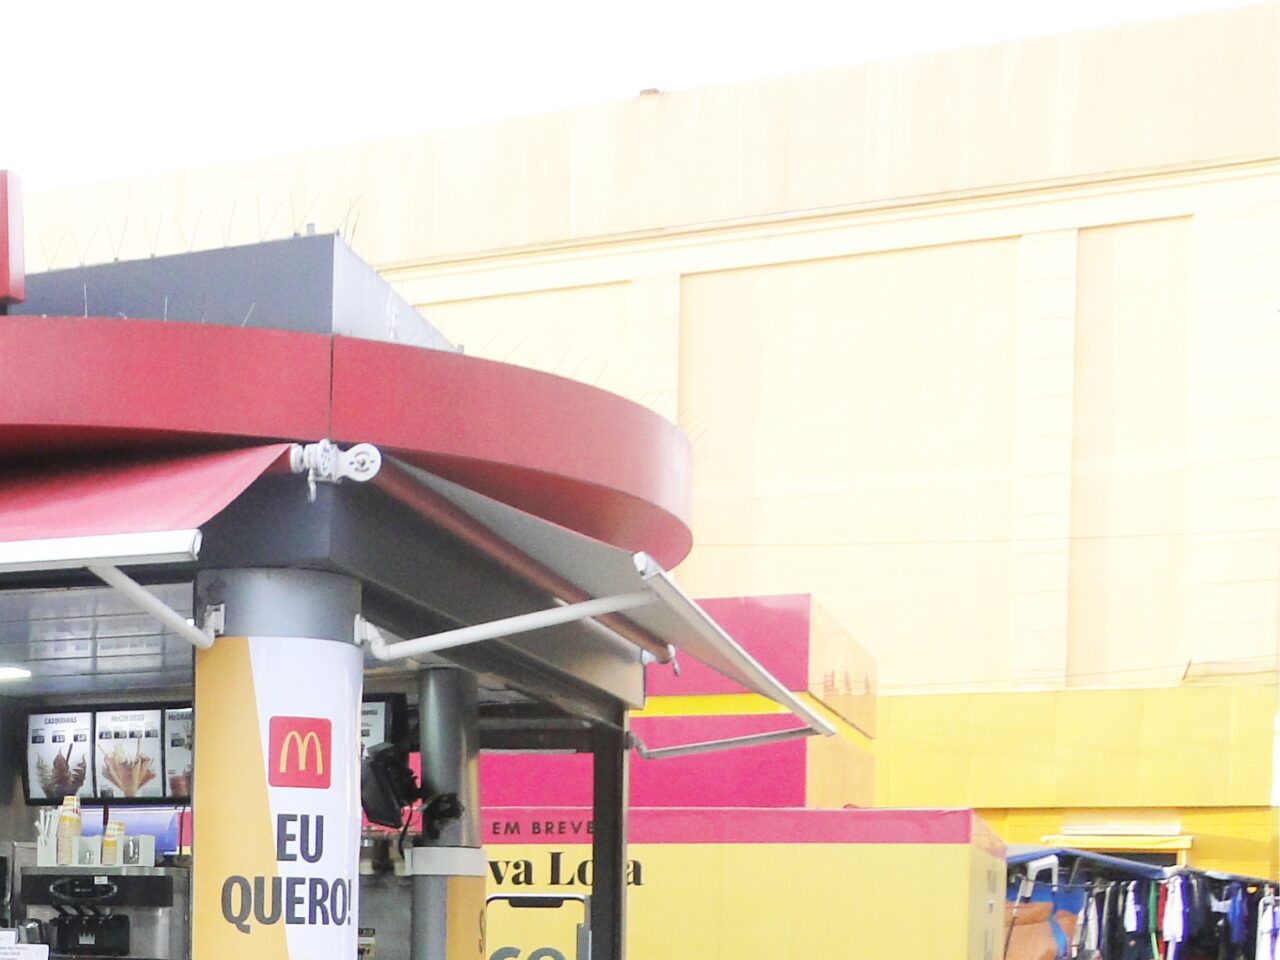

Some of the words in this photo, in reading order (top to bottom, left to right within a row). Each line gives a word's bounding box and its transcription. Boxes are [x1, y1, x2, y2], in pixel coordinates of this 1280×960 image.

[277, 813, 324, 863] EU
[492, 821, 521, 835] EM
[532, 821, 594, 835] BREVE
[488, 859, 534, 887] va
[547, 851, 643, 887] Loa
[221, 875, 352, 935] QUERO!
